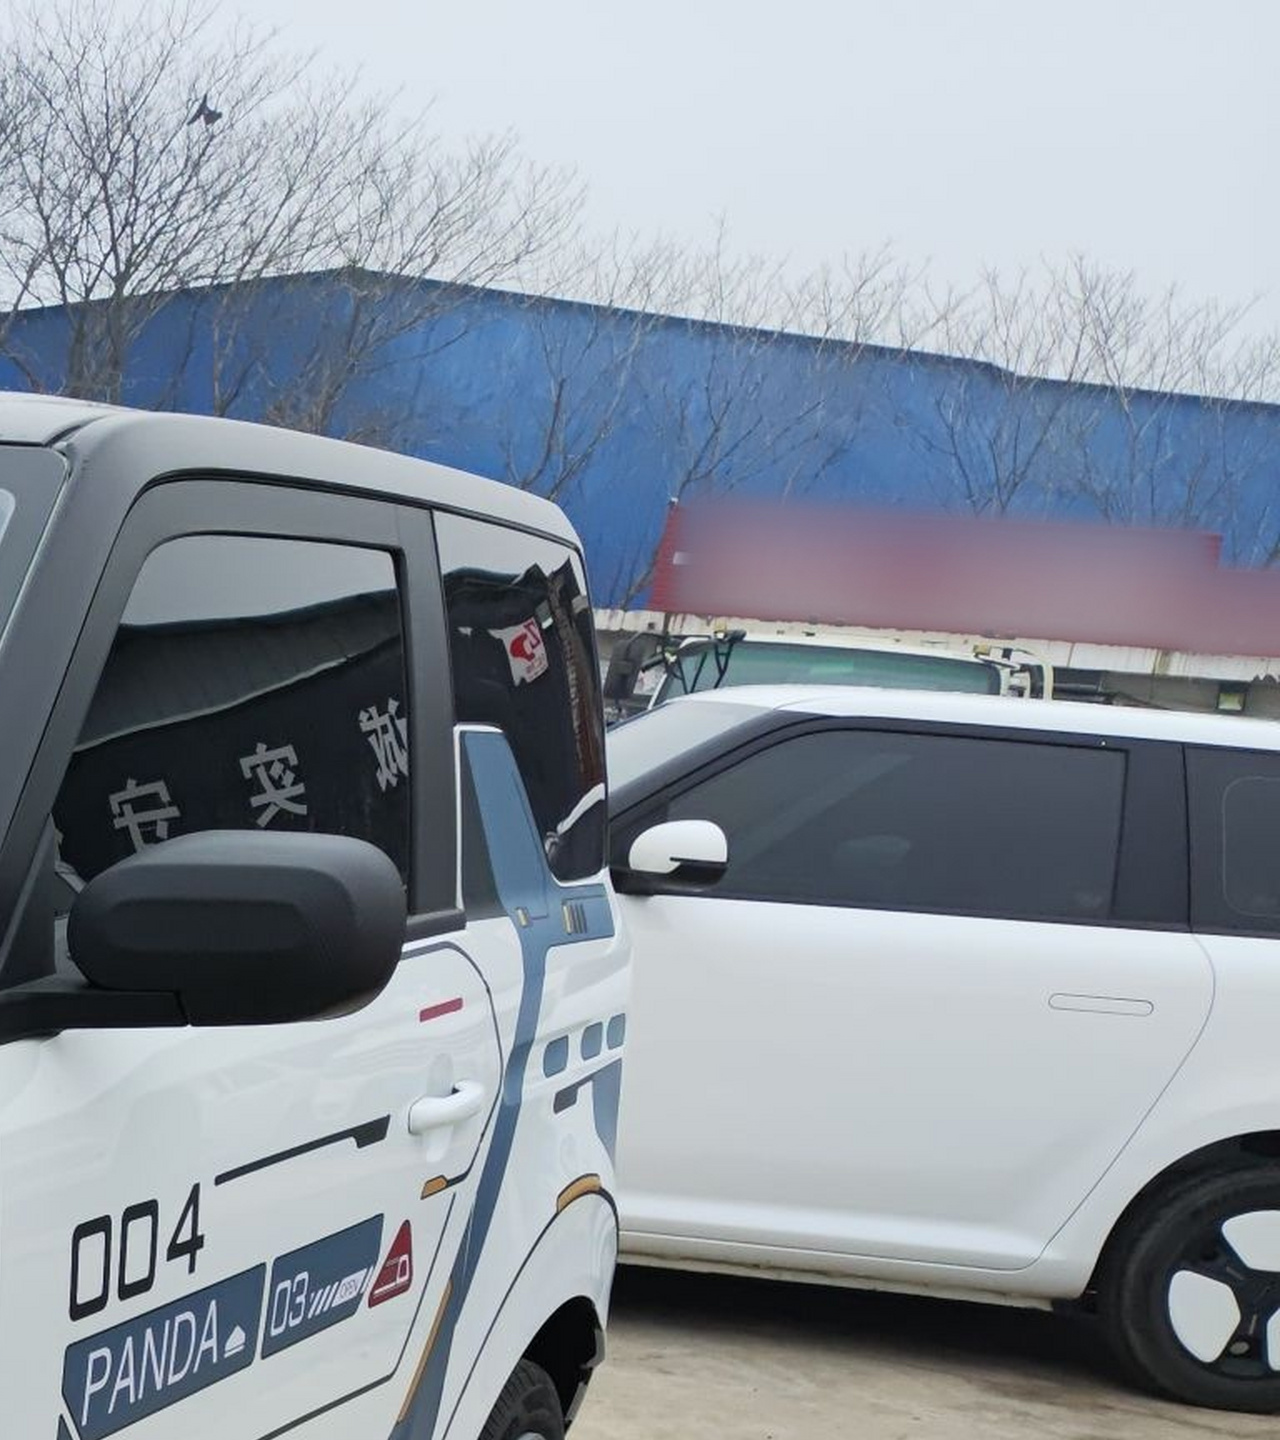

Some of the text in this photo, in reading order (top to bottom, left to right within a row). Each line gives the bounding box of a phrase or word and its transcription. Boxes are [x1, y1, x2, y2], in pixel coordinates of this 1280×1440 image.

[69, 1182, 205, 1322] 004
[81, 1271, 309, 1427] PANDA 03
